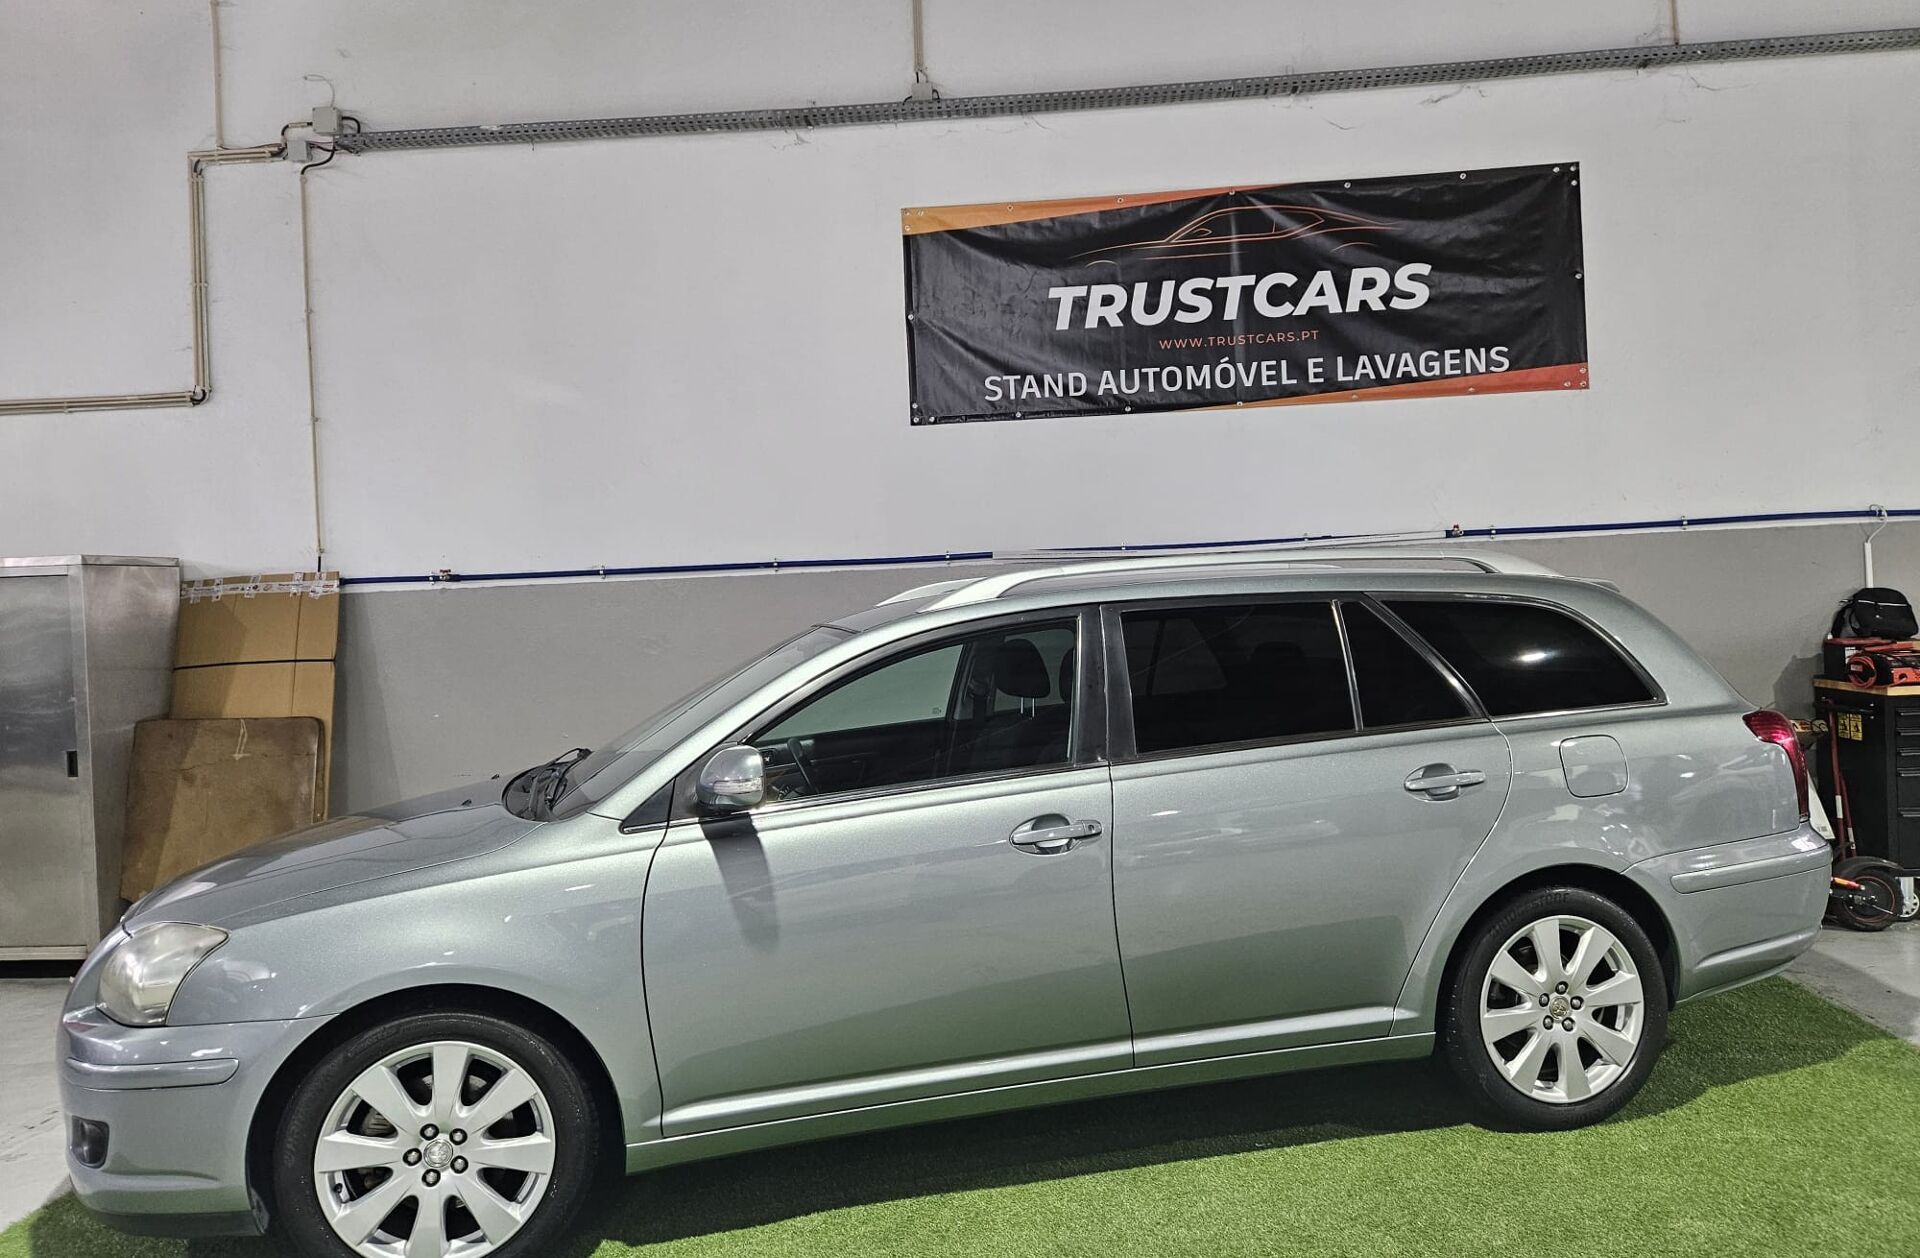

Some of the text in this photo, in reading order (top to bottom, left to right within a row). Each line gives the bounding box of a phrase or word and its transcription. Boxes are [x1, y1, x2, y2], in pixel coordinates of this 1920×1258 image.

[1048, 262, 1432, 331] TRUSTCARS
[1158, 329, 1320, 350] WWW.TRUSTCARS.PT
[984, 346, 1511, 402] STAND AUTOMÓVEL E LAVAGENS
